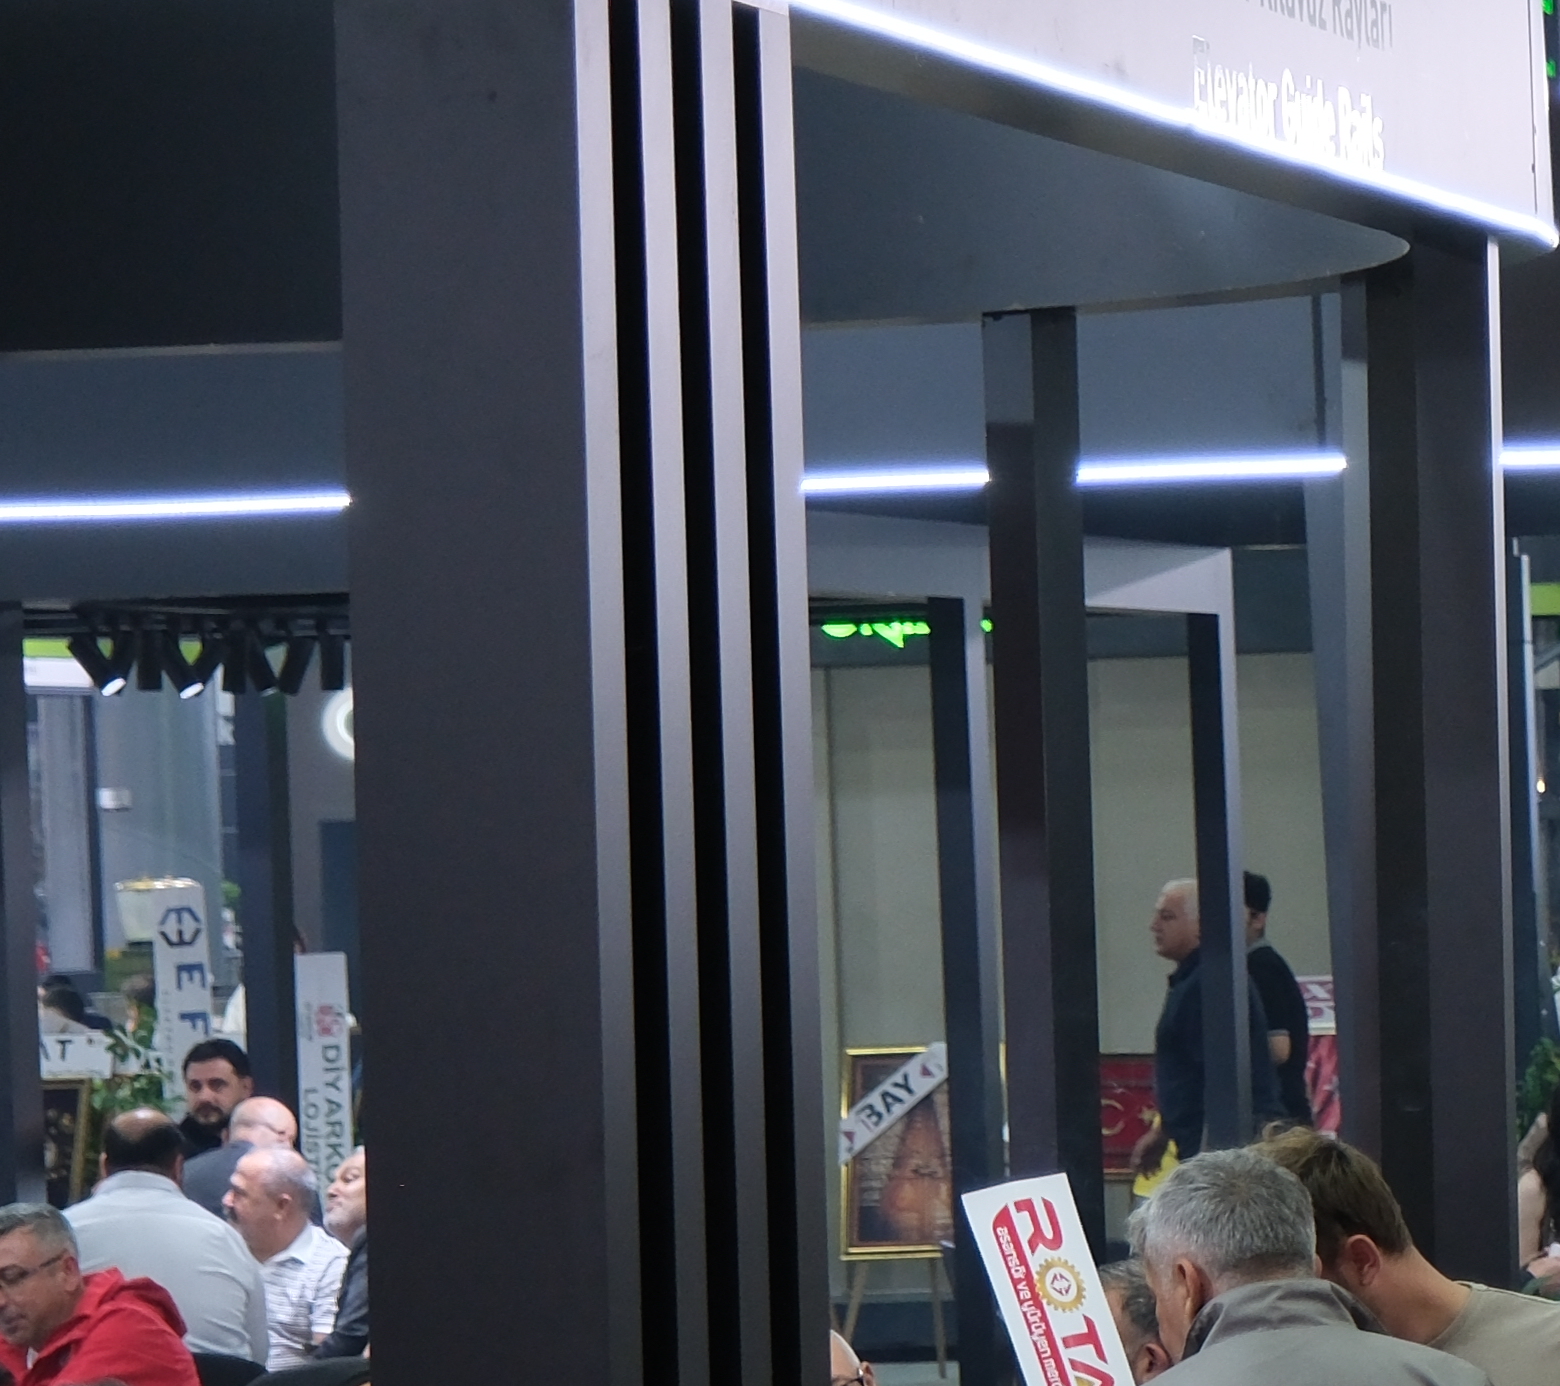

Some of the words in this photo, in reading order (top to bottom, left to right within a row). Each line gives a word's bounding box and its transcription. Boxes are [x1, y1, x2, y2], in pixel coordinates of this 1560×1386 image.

[1192, 35, 1277, 141] Elevator
[1281, 69, 1336, 159] Guide
[1337, 87, 1386, 173] Rails
[997, 1227, 1026, 1280] asansör
[1021, 1299, 1051, 1358] yürüyen
